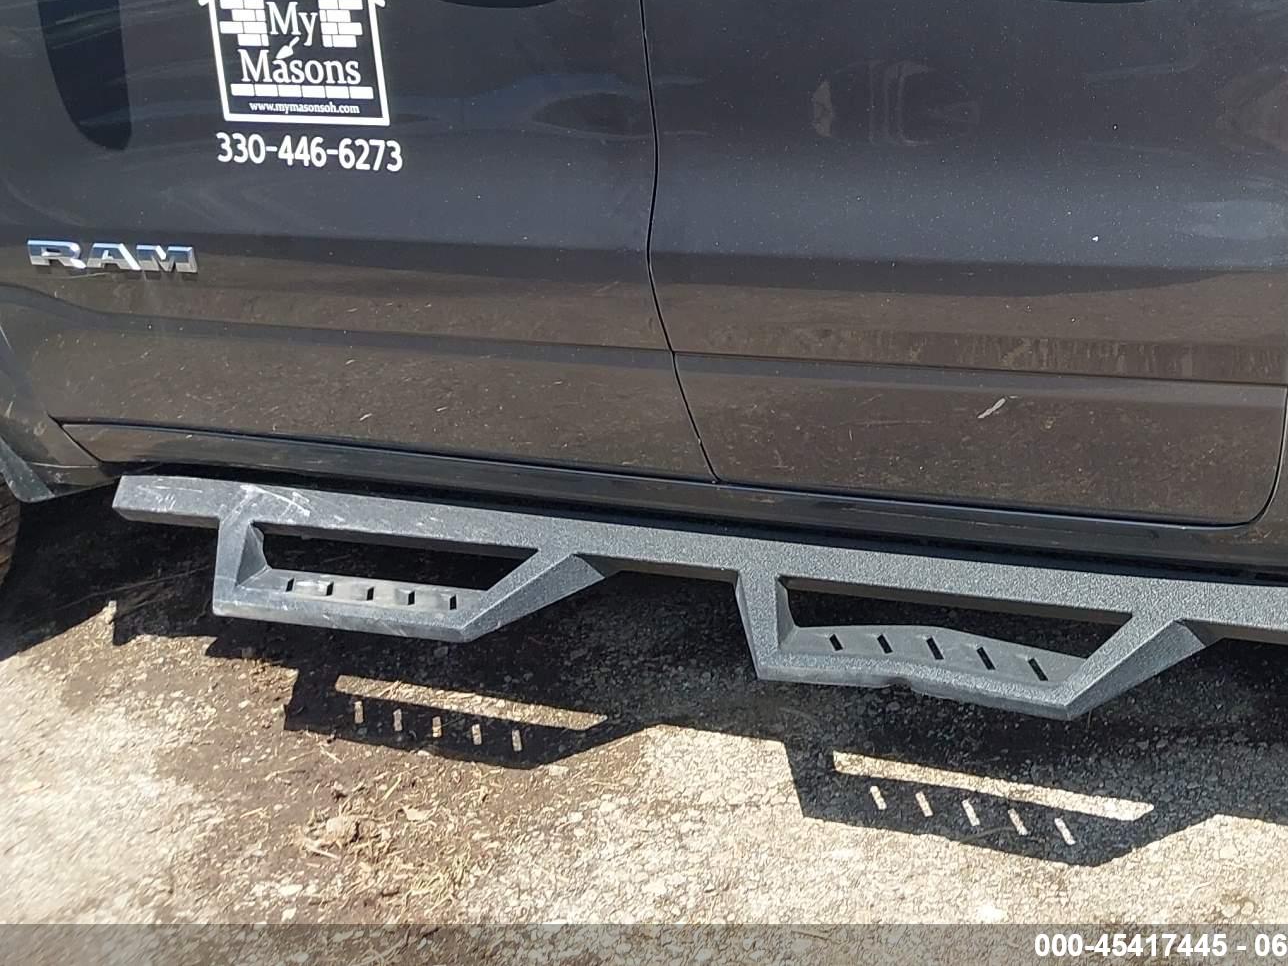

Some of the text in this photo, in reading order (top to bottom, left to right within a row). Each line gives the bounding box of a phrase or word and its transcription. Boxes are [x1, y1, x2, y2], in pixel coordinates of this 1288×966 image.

[266, 1, 318, 46] My
[237, 49, 362, 84] Masons
[249, 101, 361, 115] www.mymasonsoh.com
[216, 132, 404, 172] 330-446-6273
[27, 239, 198, 274] RAM
